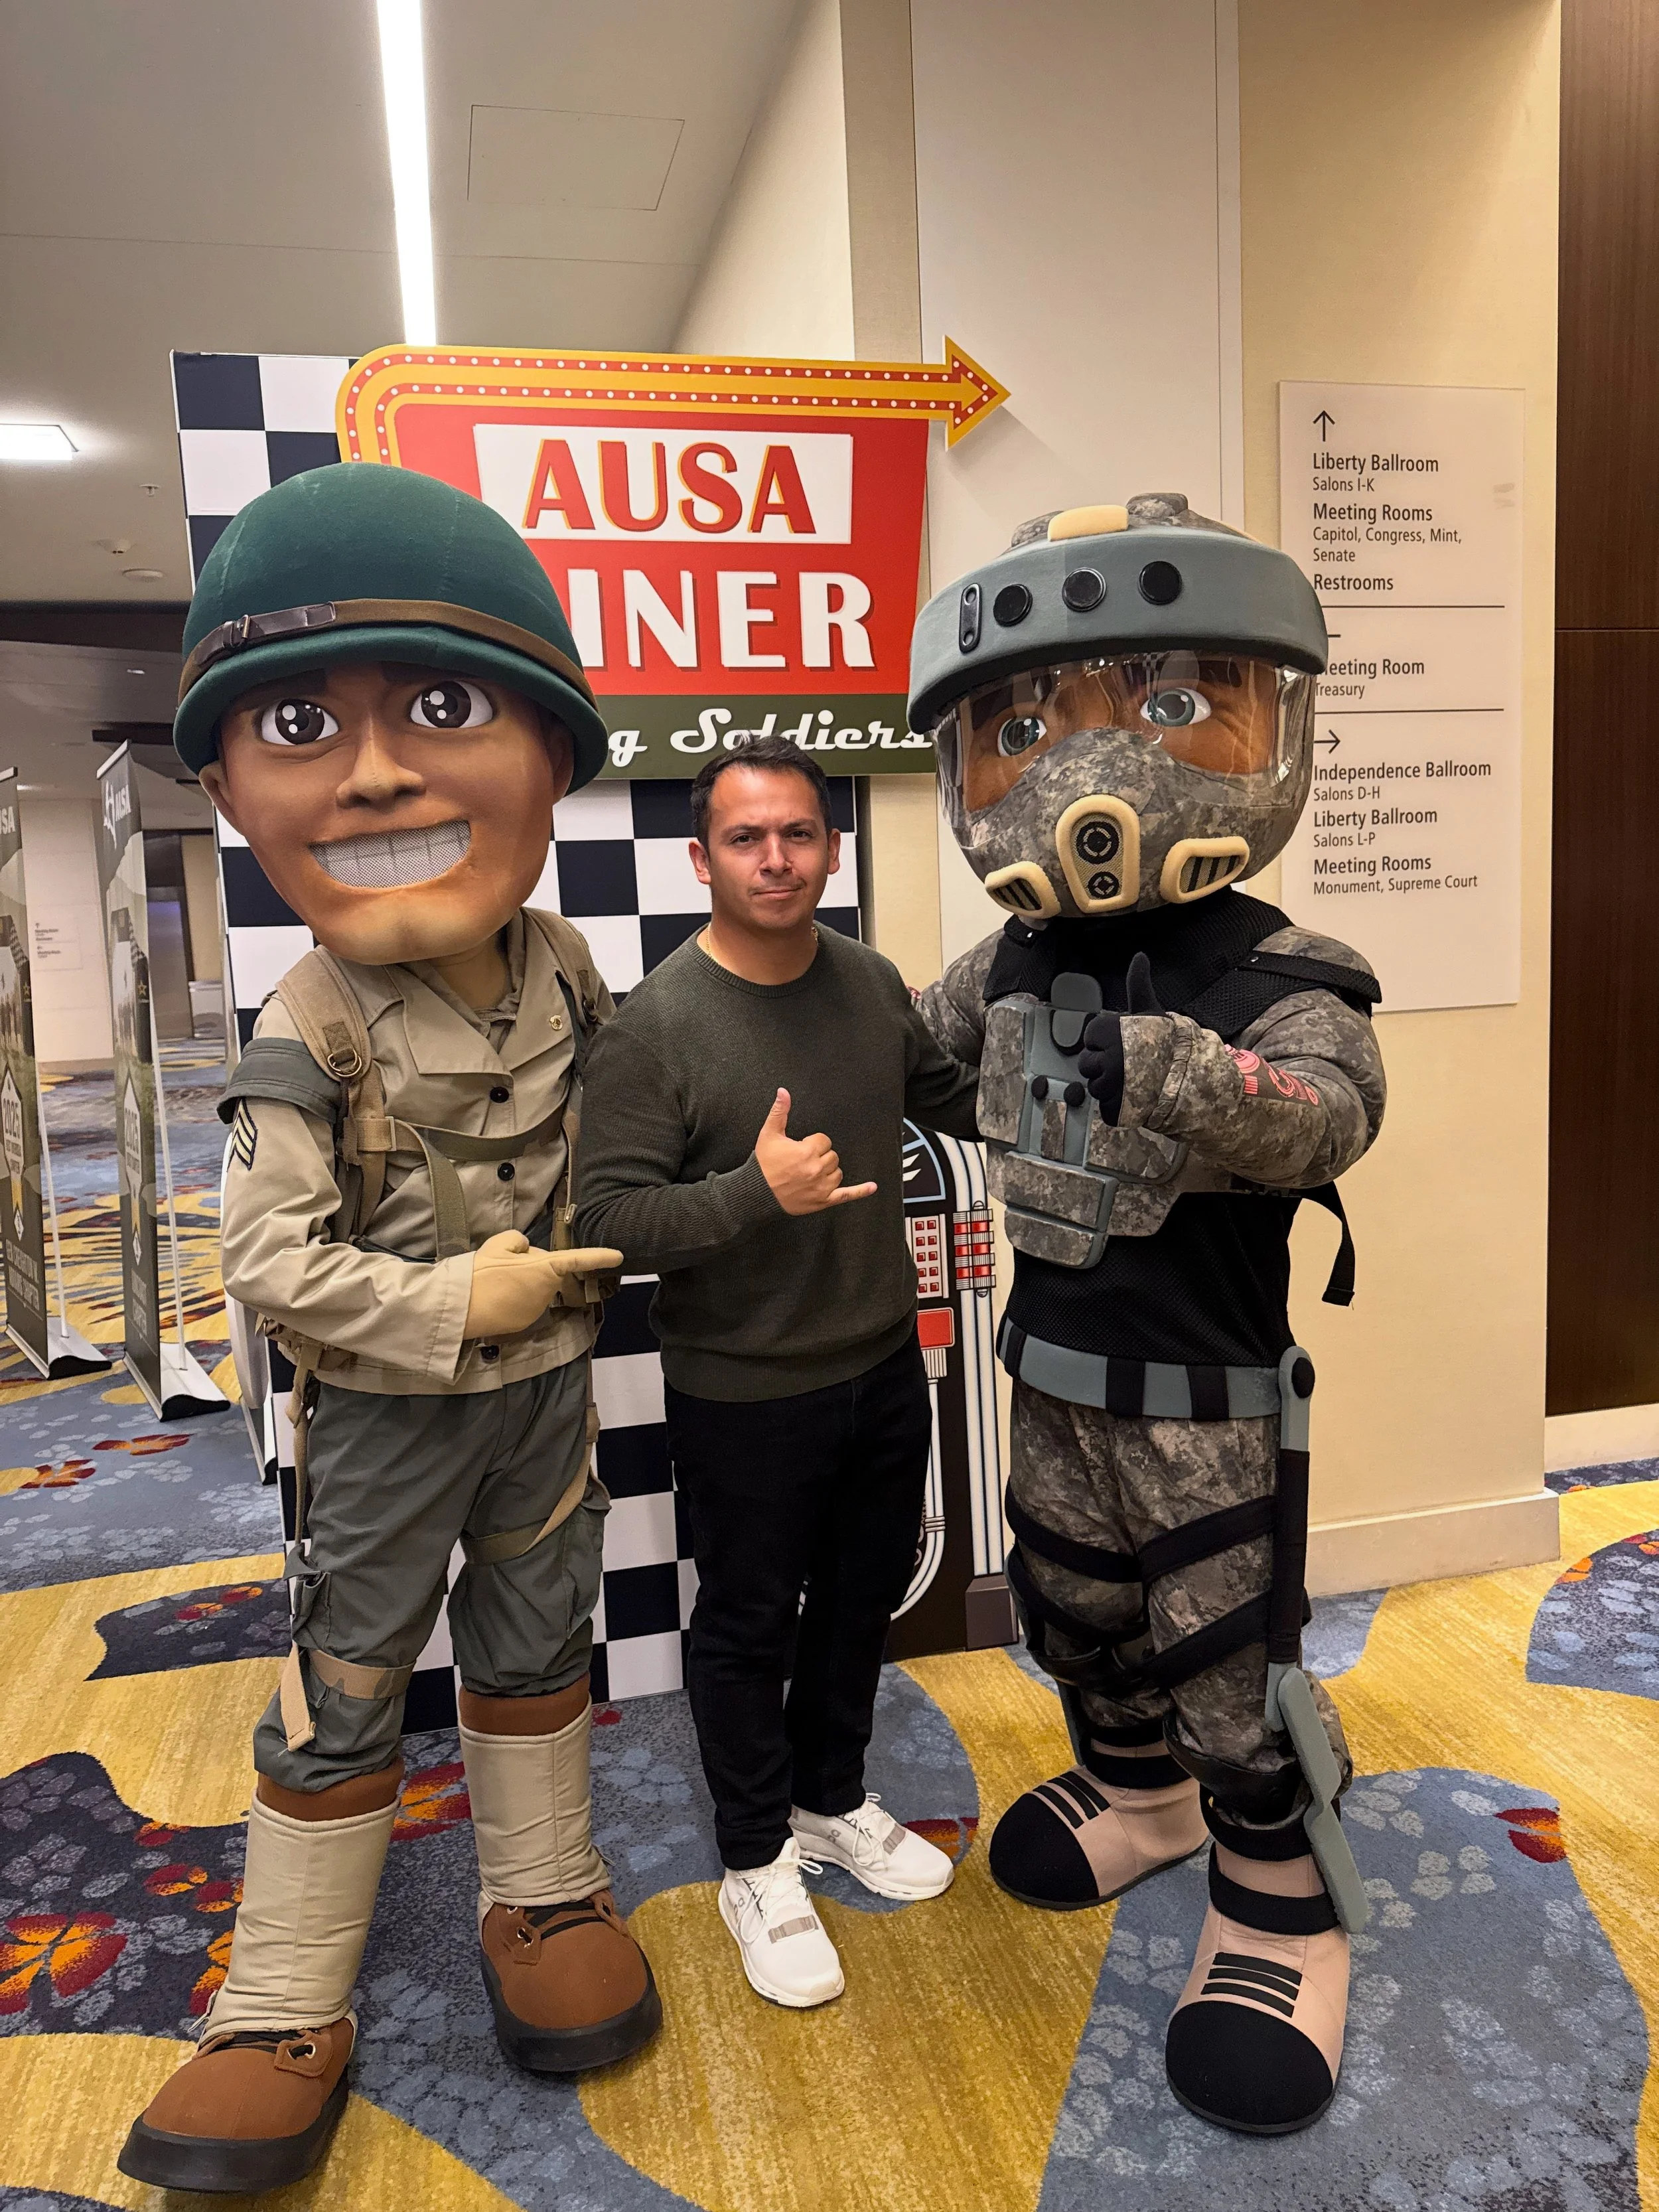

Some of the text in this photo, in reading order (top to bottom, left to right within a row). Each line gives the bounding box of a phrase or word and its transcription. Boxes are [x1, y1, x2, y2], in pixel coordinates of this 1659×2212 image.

[1313, 452, 1439, 475] Liberty Ballroom
[522, 437, 816, 535] AUSA
[1313, 476, 1376, 492] Salons I-K
[1313, 502, 1433, 525] Meeting Rooms
[1313, 526, 1462, 546] Capitol, Congress, Mint,
[1313, 547, 1356, 563] Senate
[1313, 573, 1394, 591] Restrooms
[567, 568, 876, 672] INER
[1323, 658, 1425, 680] eeting Room
[1316, 682, 1366, 700] Treasury
[1314, 759, 1492, 784] Independence Ballroom
[1313, 786, 1381, 802] Salons D-H
[1313, 807, 1438, 830] Liberty Ballroom
[1313, 832, 1376, 848] Salons L-P
[1313, 855, 1432, 877] Meeting Rooms
[1313, 875, 1478, 896] Monument, Supreme Court
